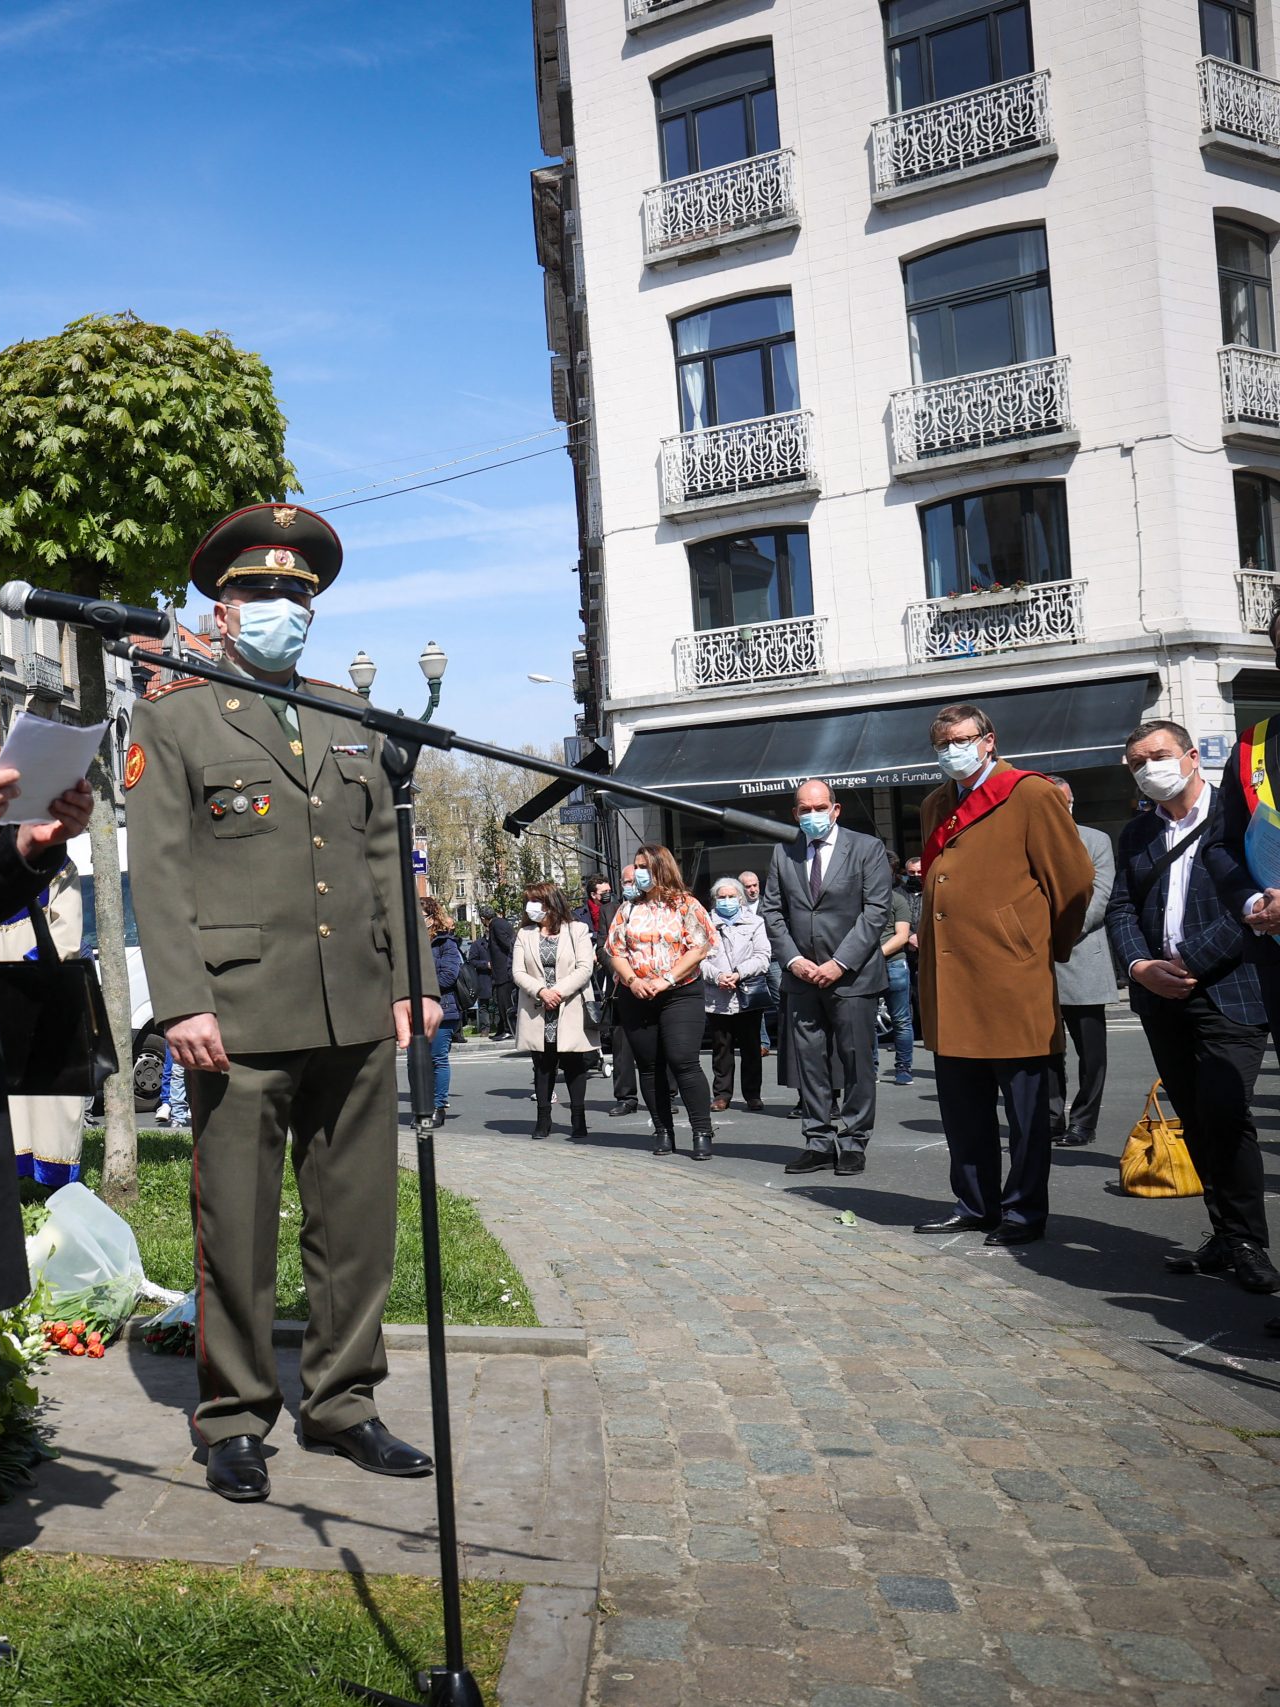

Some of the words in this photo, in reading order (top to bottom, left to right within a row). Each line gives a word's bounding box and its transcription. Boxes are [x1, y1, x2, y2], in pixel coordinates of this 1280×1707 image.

[739, 781, 785, 794] Thibaut
[875, 774, 889, 782] Art
[892, 773, 899, 782] &
[902, 772, 942, 781] Furniture
